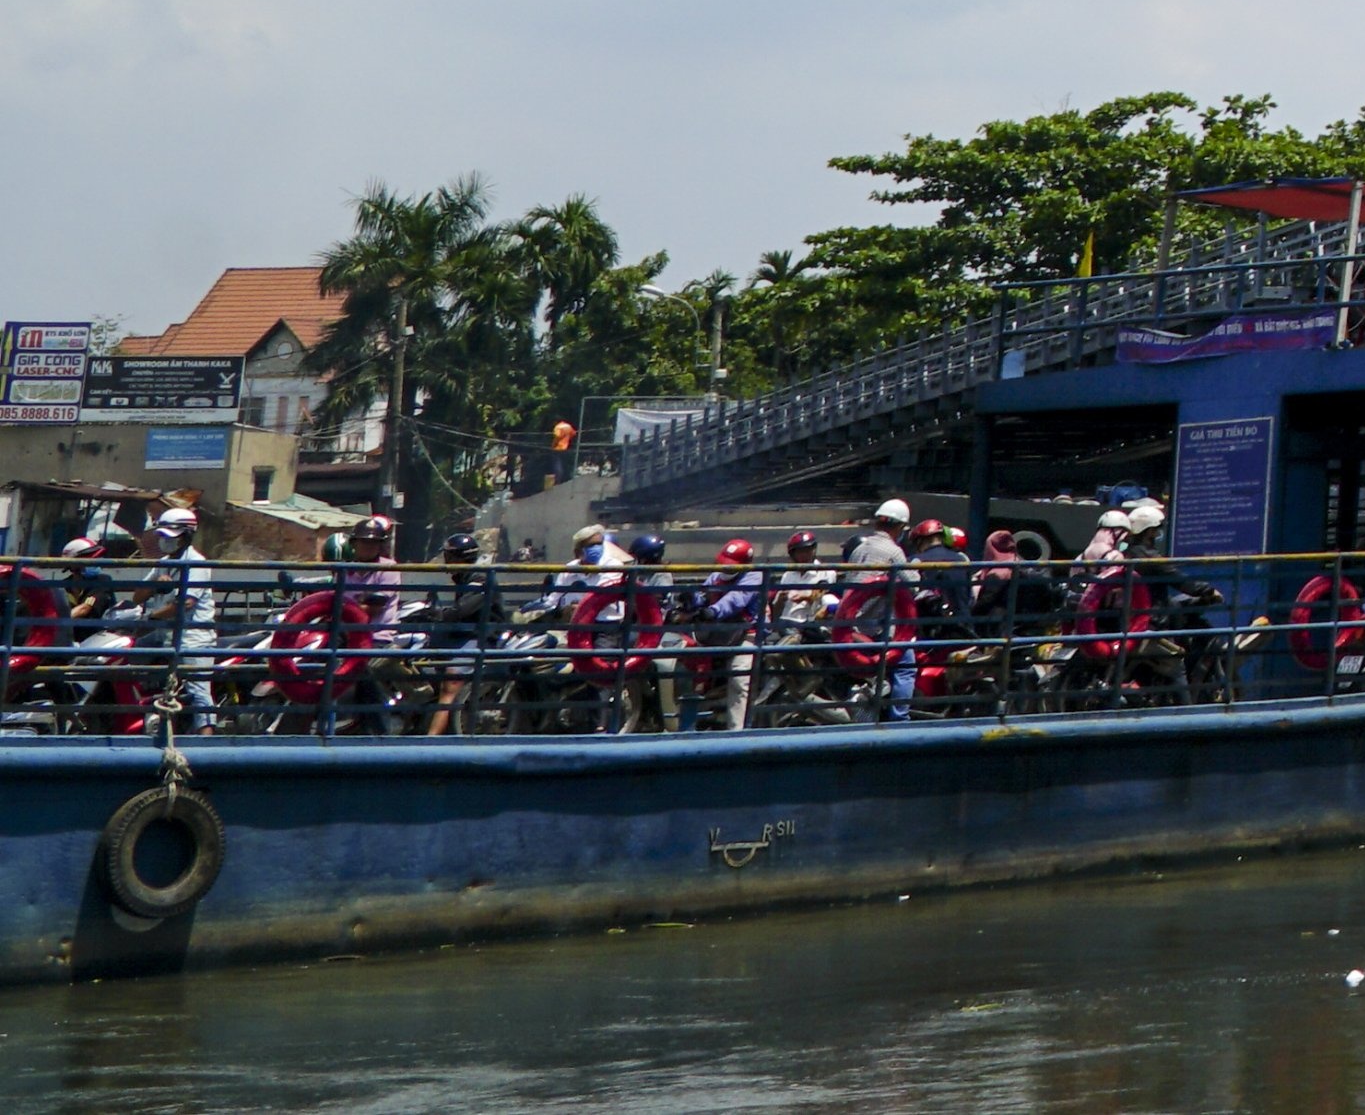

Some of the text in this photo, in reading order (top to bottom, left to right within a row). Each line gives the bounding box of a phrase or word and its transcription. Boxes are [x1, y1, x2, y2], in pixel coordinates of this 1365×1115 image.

[18, 355, 40, 366] GIA
[123, 360, 170, 368] SHOWROOM
[183, 360, 210, 368] THANH
[210, 360, 232, 368] KAKA
[16, 367, 80, 376] LASER-CNC
[1207, 428, 1223, 439] THU
